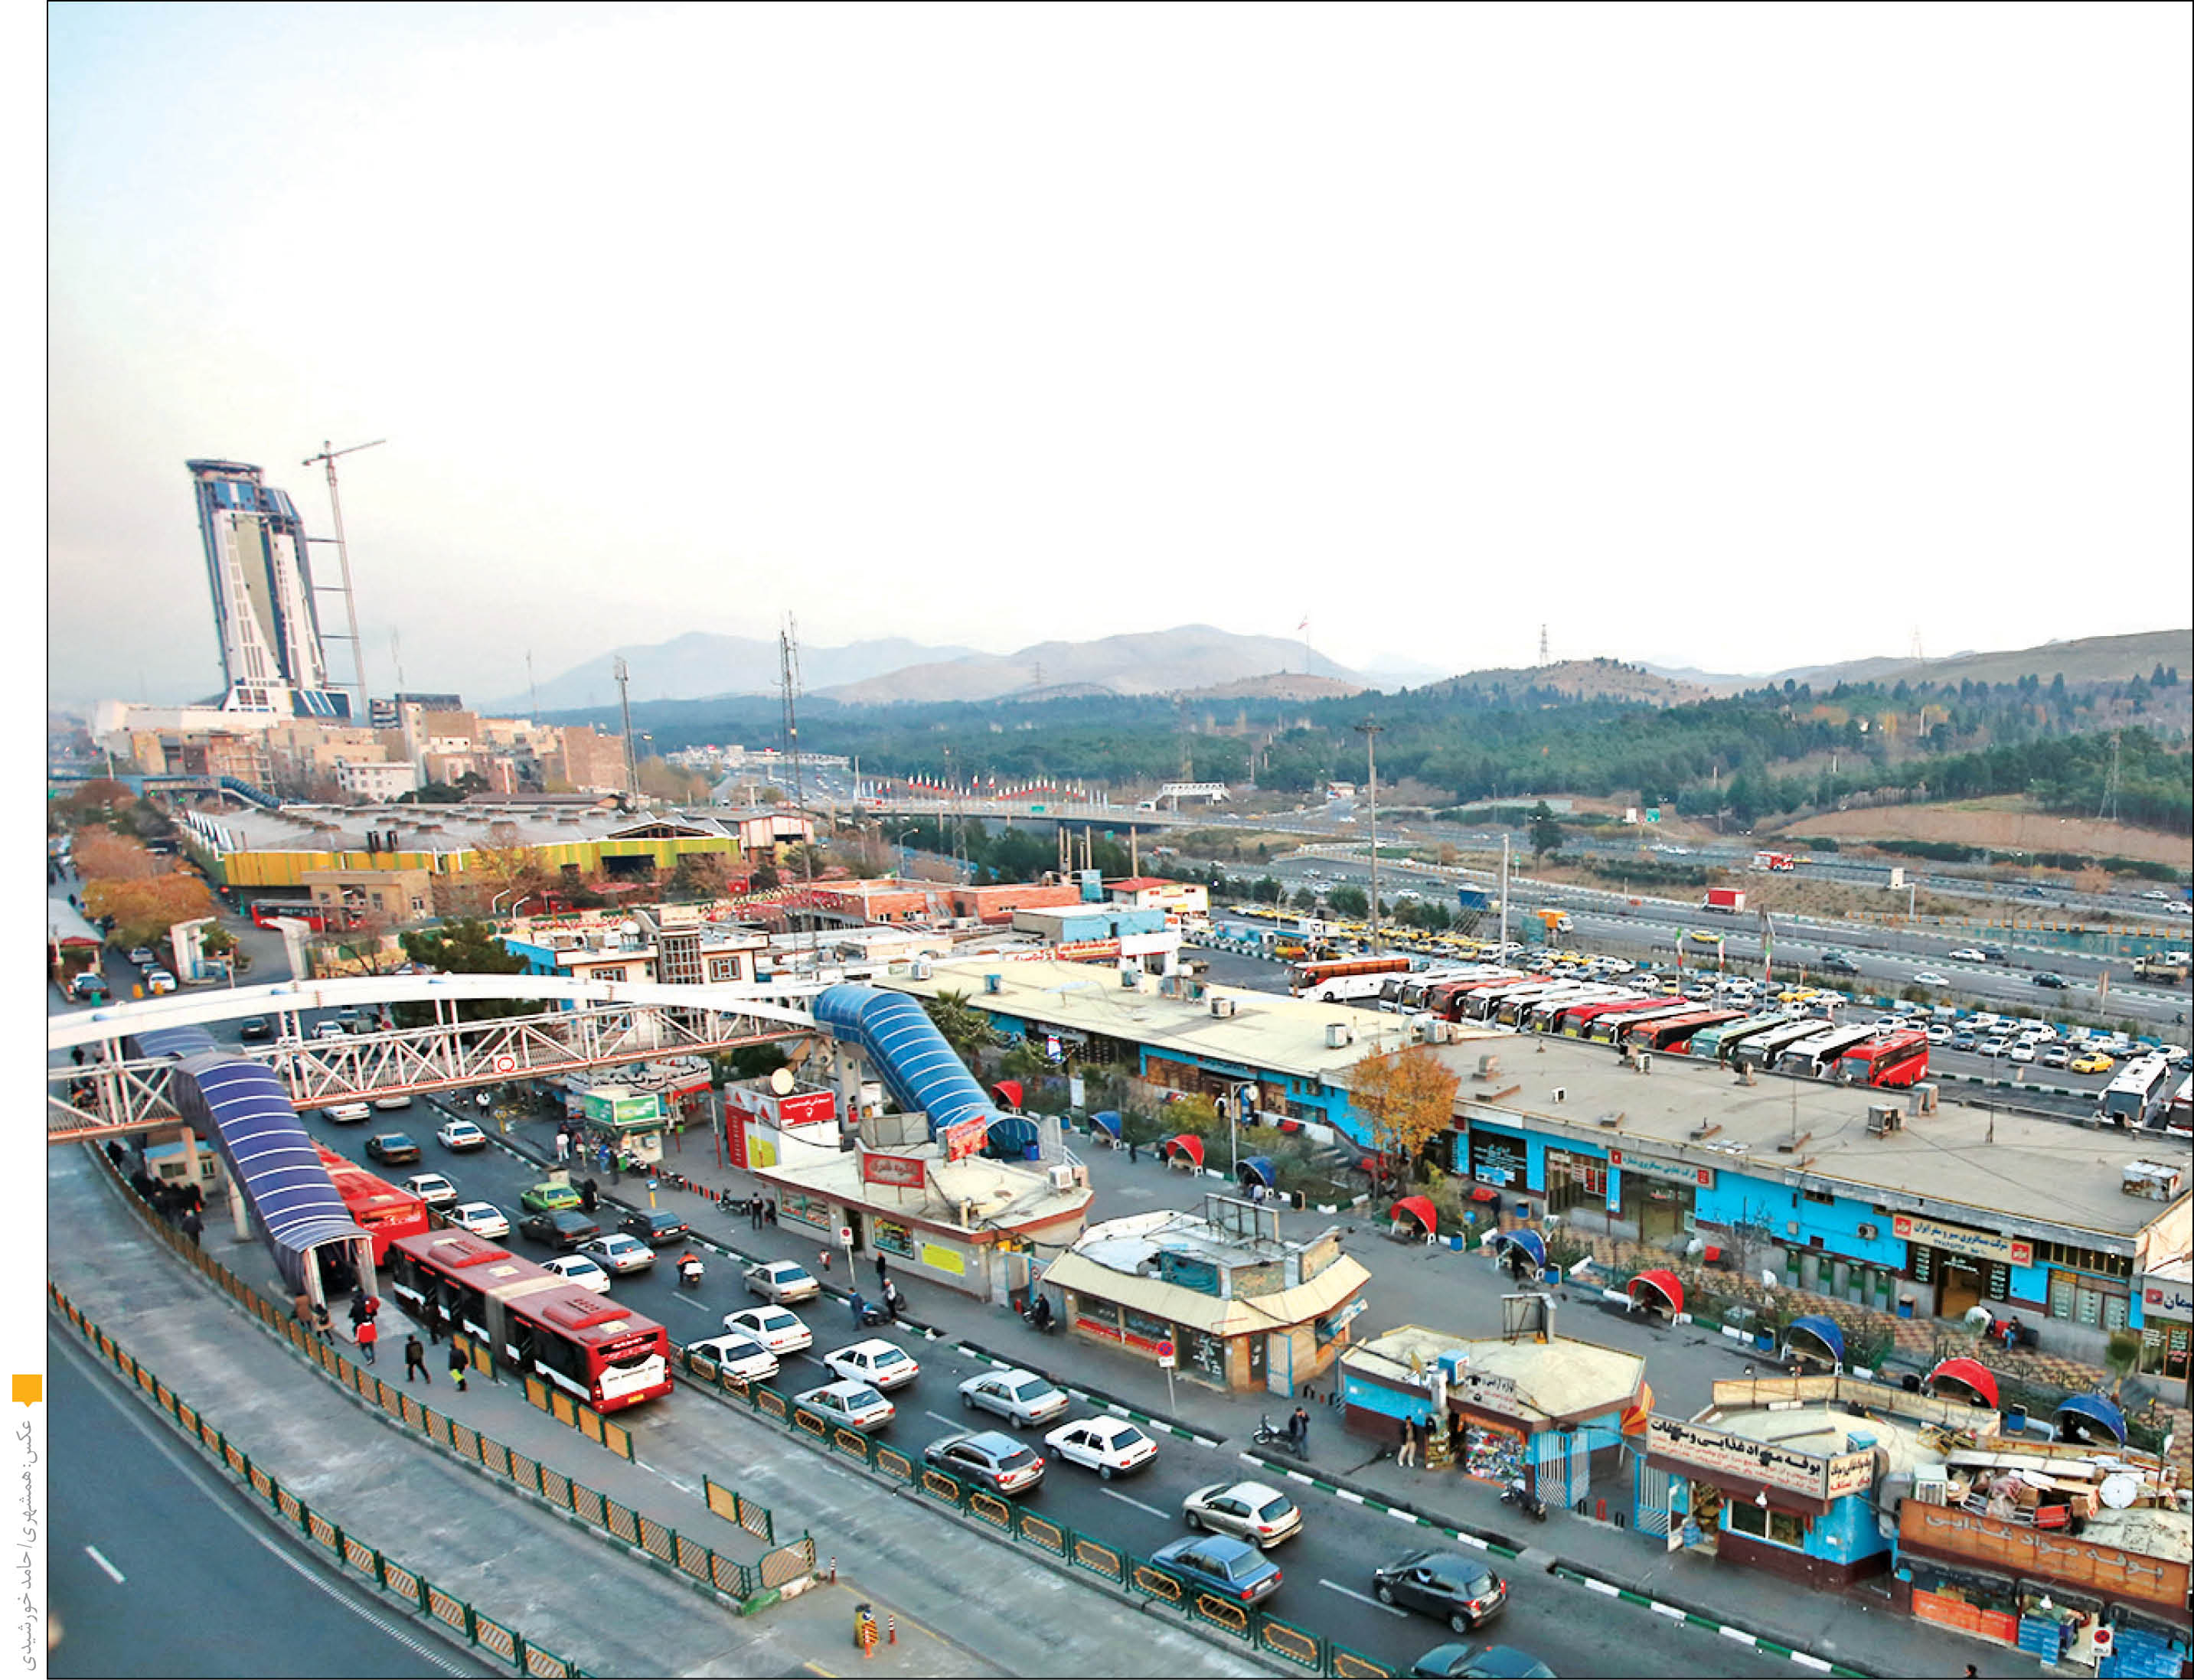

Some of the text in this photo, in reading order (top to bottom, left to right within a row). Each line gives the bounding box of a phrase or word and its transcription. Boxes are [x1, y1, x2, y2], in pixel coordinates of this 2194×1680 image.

[1695, 1437, 1745, 1454] غذایی
[1746, 1445, 1783, 1466] ماد
[1784, 1456, 1820, 1476] بوفه
[1925, 1514, 2163, 1578] بوفه مواد غذایی
